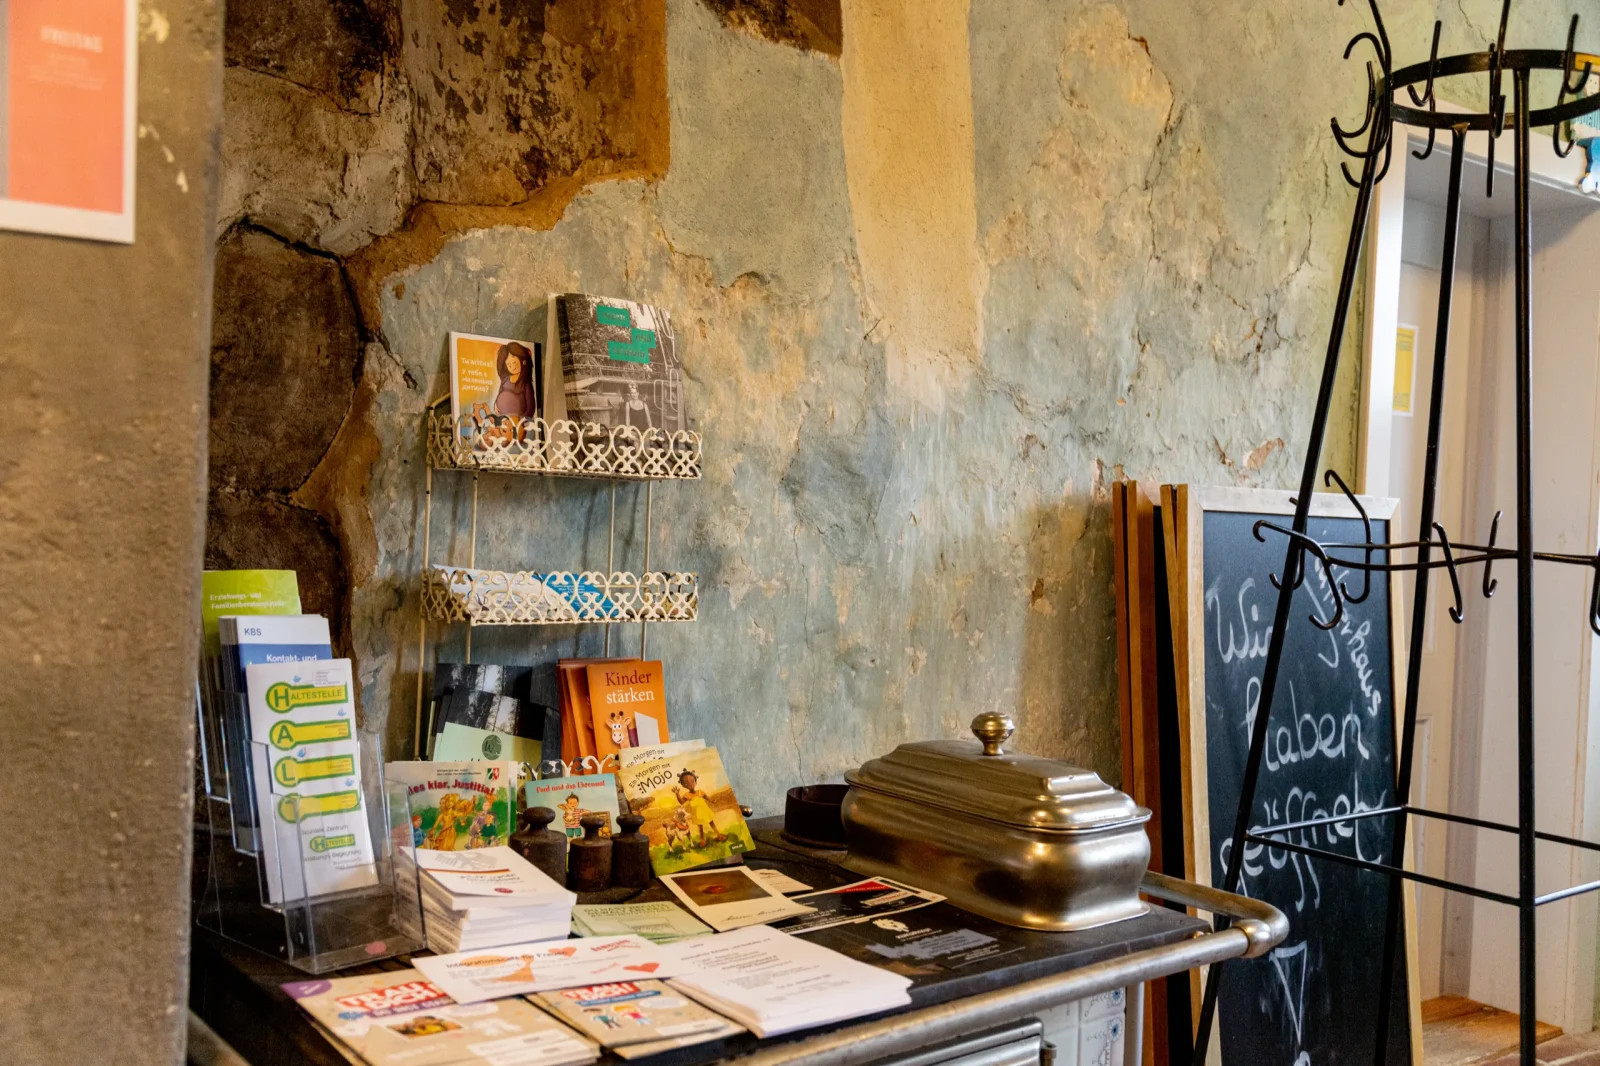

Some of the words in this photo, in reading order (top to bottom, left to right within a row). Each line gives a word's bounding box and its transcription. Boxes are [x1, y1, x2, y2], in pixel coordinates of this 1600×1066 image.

[244, 628, 262, 636] KBS
[266, 653, 301, 662] Kontakt-
[605, 669, 652, 686] Kinder
[273, 688, 343, 708] HALTESTELLE
[606, 688, 655, 704] stärken
[1240, 676, 1370, 772] haben
[277, 724, 293, 744] A
[633, 748, 657, 761] Morgen
[281, 763, 296, 782] L
[628, 779, 638, 789] Ein
[635, 763, 661, 780] Morgen
[427, 780, 450, 790] klar,
[452, 779, 495, 796] Justitia!
[535, 784, 550, 793] Paul
[551, 783, 564, 792] und
[639, 770, 673, 794] Mojo
